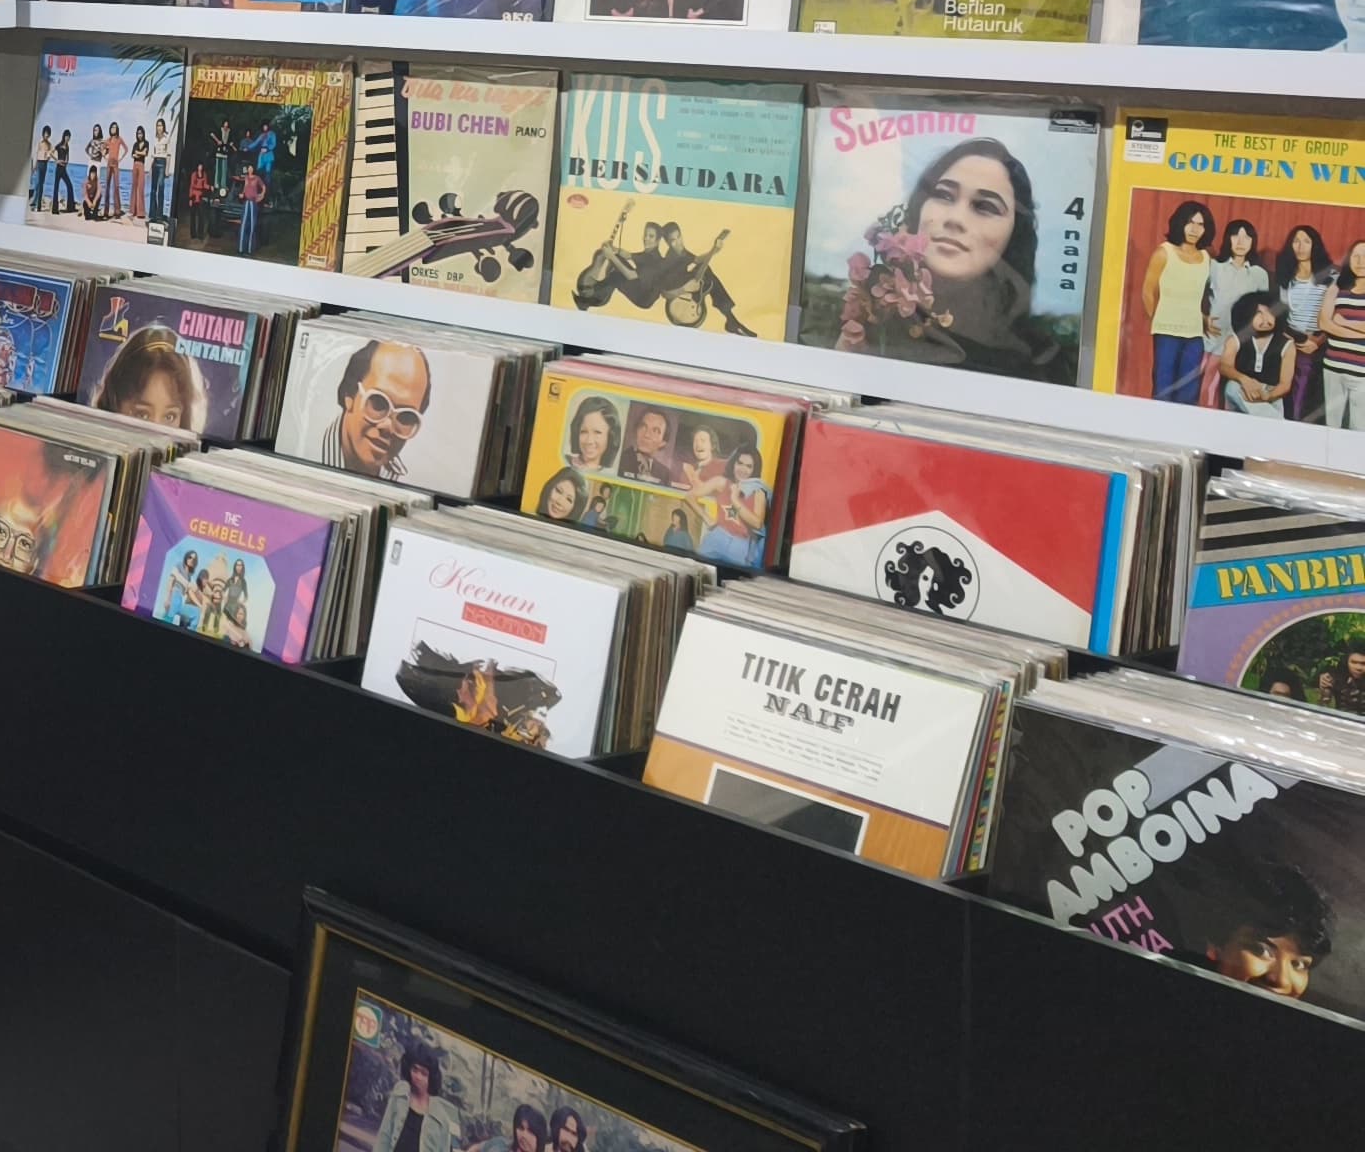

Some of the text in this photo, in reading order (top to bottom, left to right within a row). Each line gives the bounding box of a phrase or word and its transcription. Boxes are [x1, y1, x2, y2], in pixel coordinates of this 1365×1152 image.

[942, 15, 1024, 35] Hutauruk
[197, 68, 257, 86] RHYTHM
[411, 111, 547, 138] BUBI CHEN PIANO
[568, 75, 667, 193] KUS
[829, 106, 976, 153] Suzanna
[1214, 133, 1349, 157] THE BEST OF GROUP
[569, 156, 787, 197] BERSAUDARA
[1169, 151, 1296, 180] GOLDEN
[1064, 197, 1085, 221] 4
[179, 310, 246, 346] CINTAKU
[175, 337, 247, 367] CINTAMU
[189, 518, 268, 552] GEMBELLS
[224, 511, 243, 527] THE
[429, 558, 536, 615] Keenan
[741, 651, 902, 723] TITIK CERAH
[763, 692, 855, 734] NAIF
[1051, 769, 1153, 858] POP
[1047, 763, 1279, 928] AMBOINA
